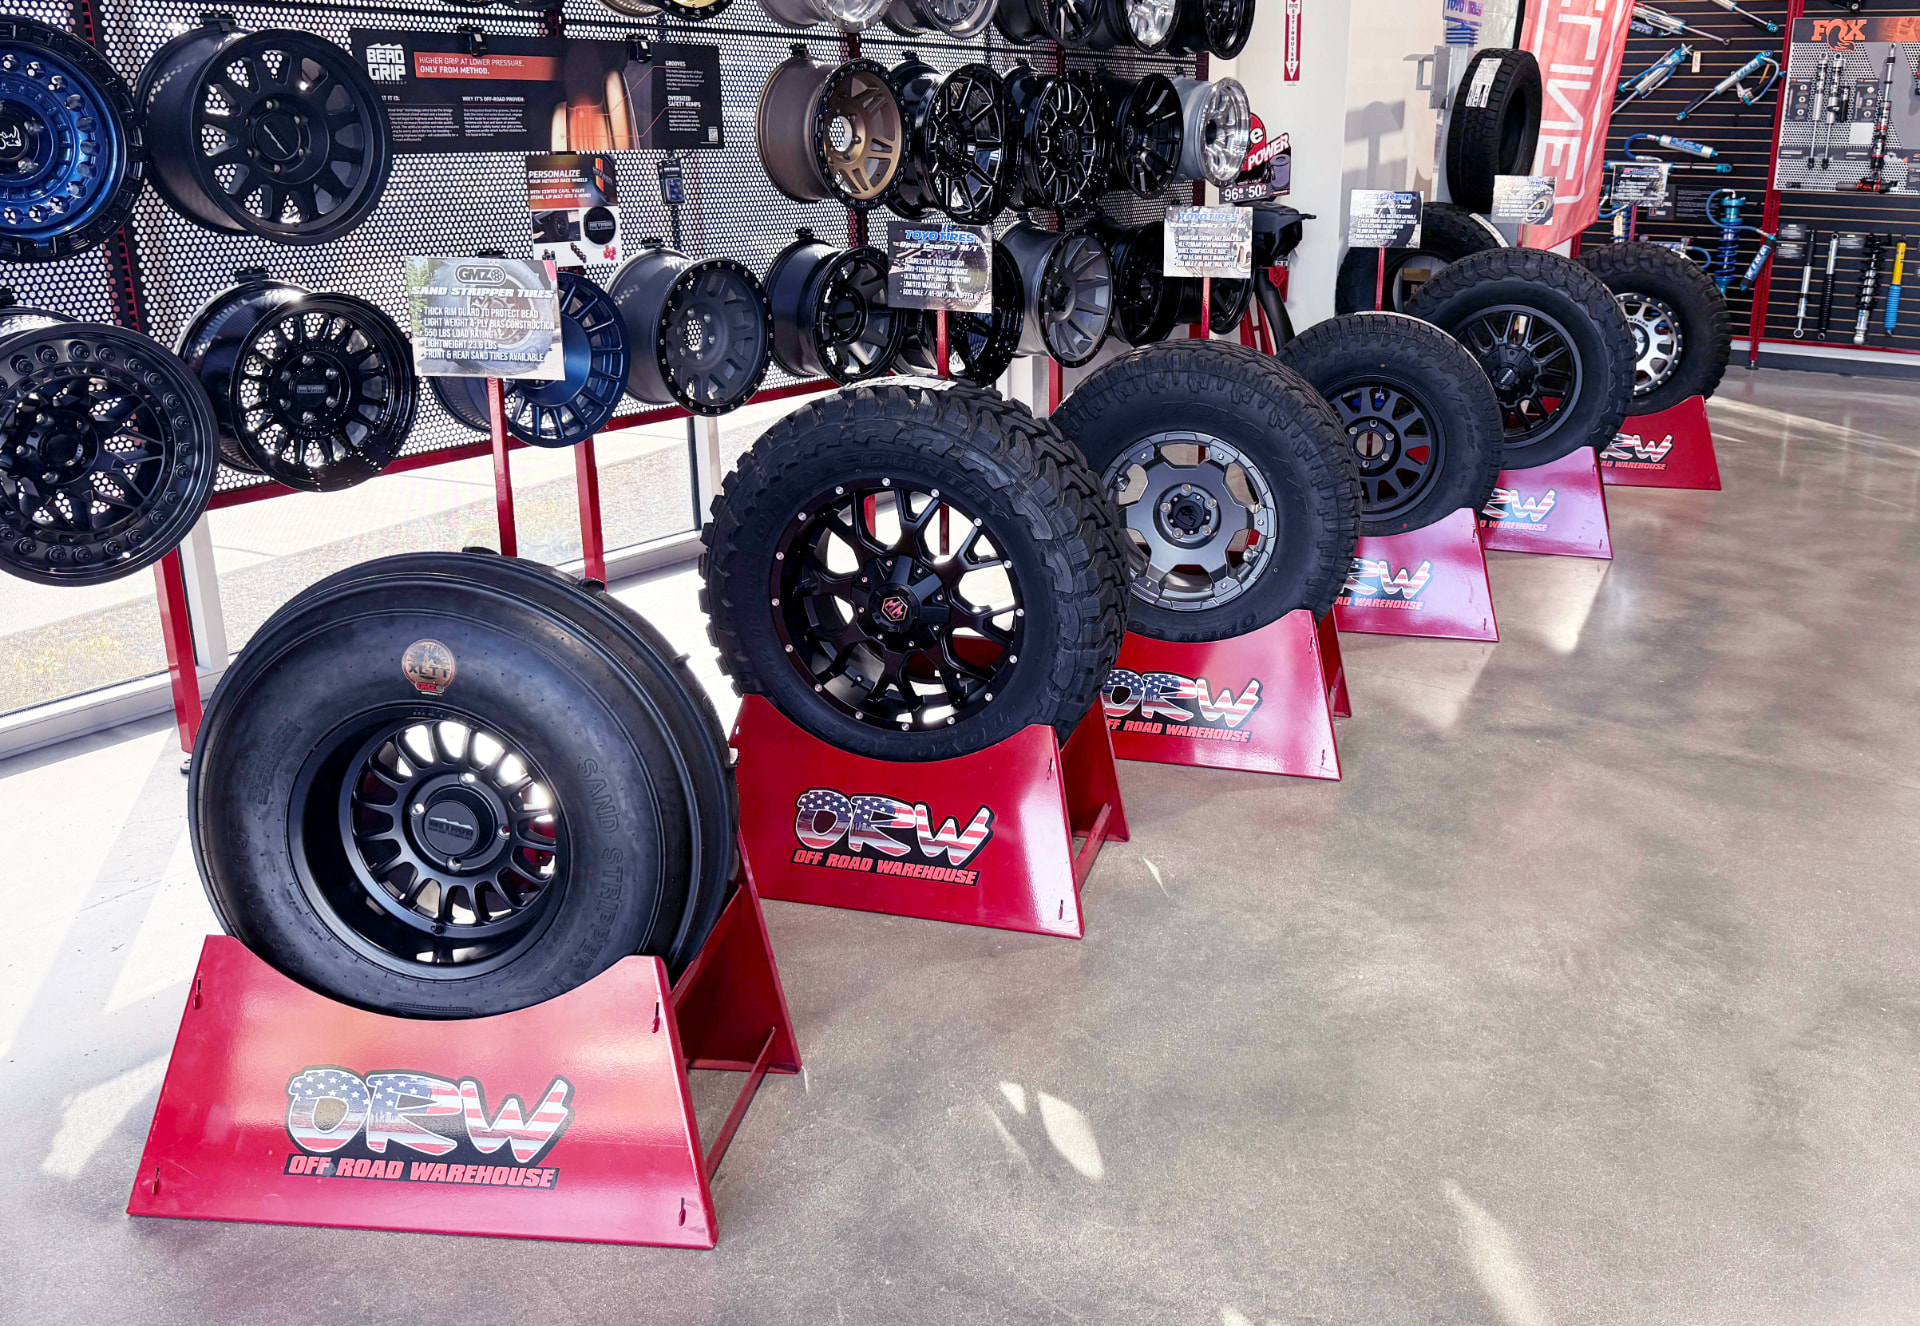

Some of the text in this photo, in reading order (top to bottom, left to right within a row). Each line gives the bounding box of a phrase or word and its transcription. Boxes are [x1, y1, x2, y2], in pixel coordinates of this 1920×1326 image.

[1811, 18, 1868, 52] FOX
[366, 48, 404, 64] BEAD
[492, 59, 524, 67] PRESSURE.
[368, 64, 406, 80] GRIP
[1248, 134, 1288, 170] POWER
[528, 170, 581, 178] PERSONALIZE
[905, 230, 975, 242] TOYO TIRES
[923, 242, 957, 251] Country
[459, 268, 491, 280] GMZ
[411, 287, 554, 298] SAND STRIPPER TIRES
[424, 307, 443, 316] THICK
[458, 308, 479, 317] GUARD
[481, 309, 490, 317] TO
[491, 309, 519, 318] PROTECT
[521, 310, 538, 318] BEAD
[490, 320, 504, 328] BIAS
[506, 320, 554, 330] CONSTRUCTION
[439, 329, 450, 337] LBS
[452, 329, 469, 338] LOAD
[470, 330, 493, 338] RATING
[424, 340, 467, 348] LIGHTWEIGHT
[485, 341, 497, 349] LBS
[424, 350, 445, 359] FRONT
[453, 351, 470, 359] REAR
[471, 352, 488, 360] SAND
[490, 352, 508, 361] TIRES
[509, 353, 544, 361] AVAILABLE
[1600, 433, 1673, 462] RW
[1615, 461, 1666, 470] WAREHOUSE
[1482, 488, 1556, 522] RW
[1489, 521, 1548, 532] WAREHOUSE
[1339, 558, 1430, 599] RW
[1354, 598, 1424, 610] WAREHOUSE
[1101, 670, 1260, 727] ORW
[1108, 719, 1250, 743] FF ROAD WAREHOUSE
[796, 790, 990, 865] ORW
[570, 758, 624, 970] SAND STRIPPER
[794, 850, 978, 885] OFF ROAD WAREHOUSE
[288, 1069, 569, 1164] ORW
[289, 1156, 555, 1188] OFF ROAD WAREHOUSE
